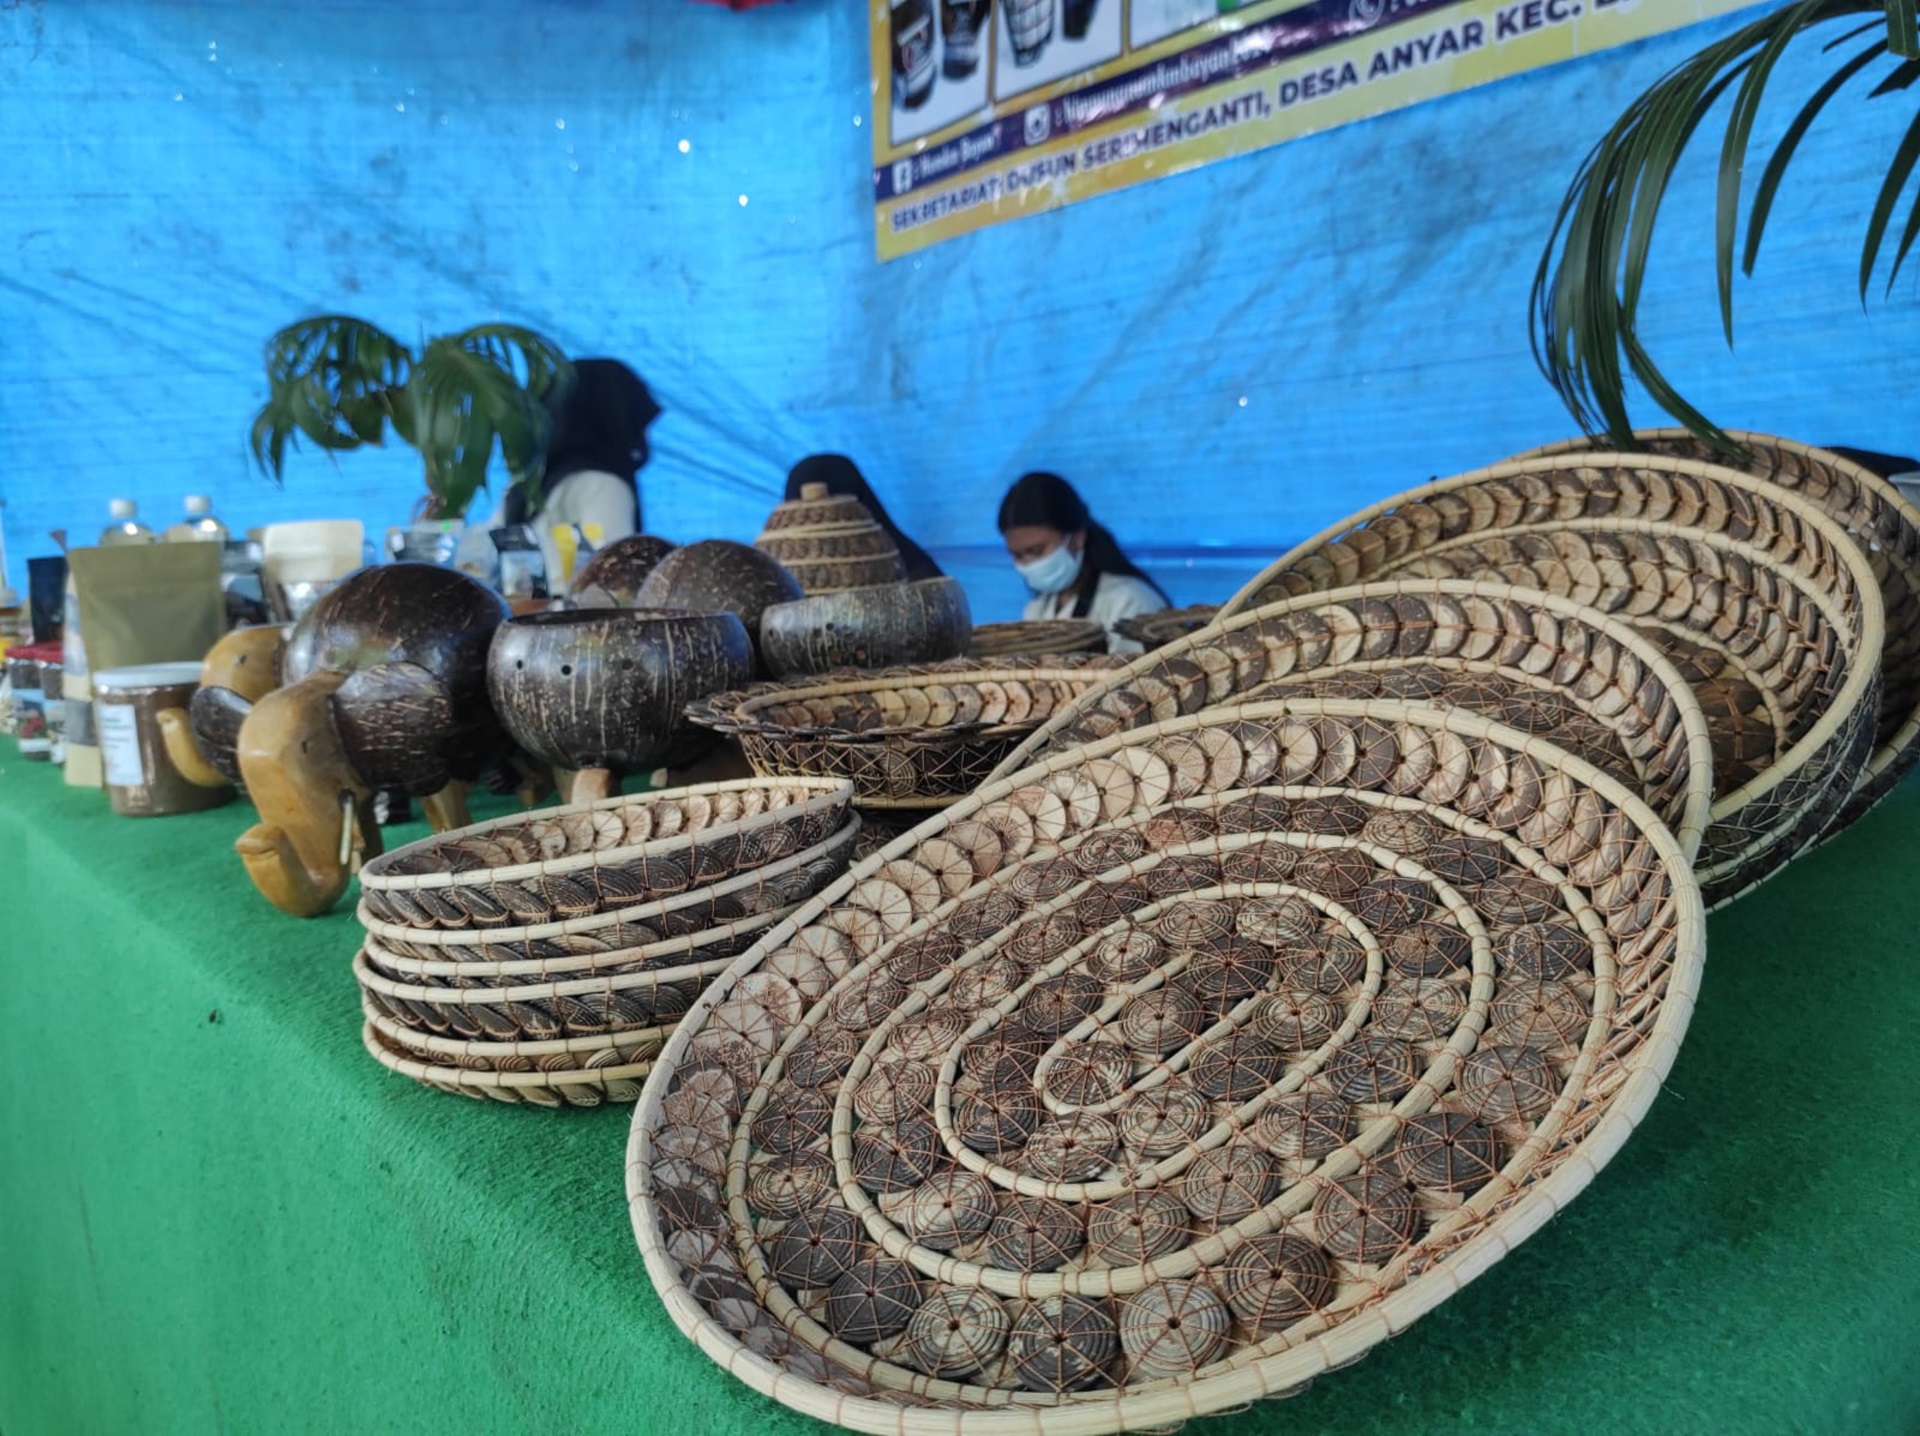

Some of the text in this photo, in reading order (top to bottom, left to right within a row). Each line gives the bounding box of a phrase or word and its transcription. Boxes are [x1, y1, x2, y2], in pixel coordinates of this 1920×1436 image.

[1279, 62, 1358, 107] DESA
[1368, 20, 1483, 79] ANYAR
[1496, 0, 1582, 40] KEC.
